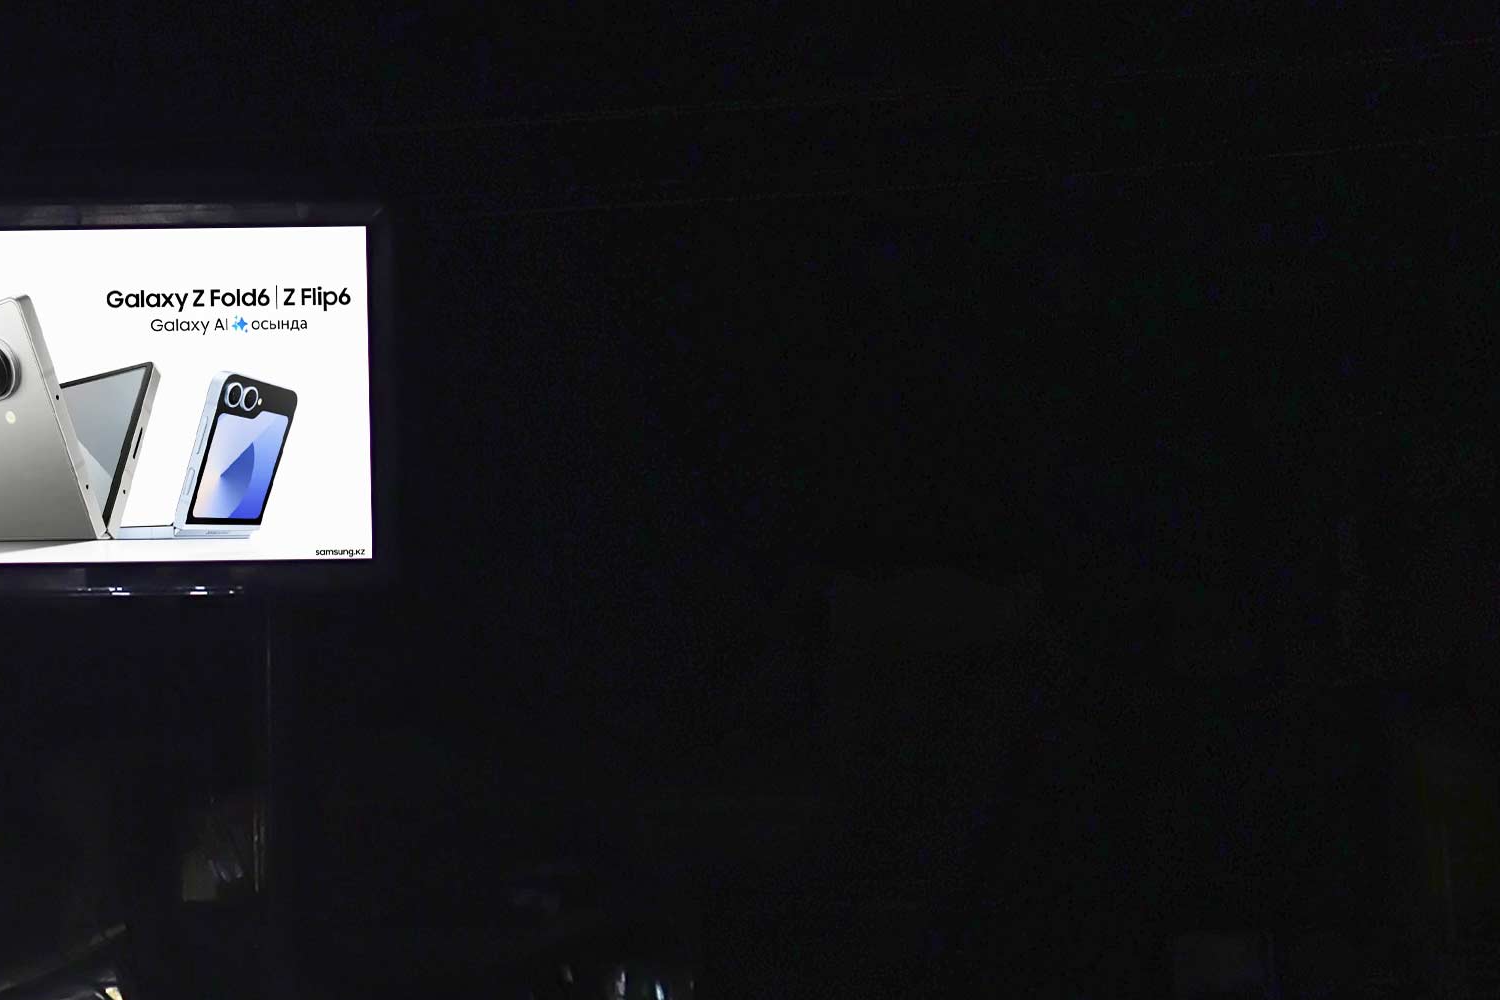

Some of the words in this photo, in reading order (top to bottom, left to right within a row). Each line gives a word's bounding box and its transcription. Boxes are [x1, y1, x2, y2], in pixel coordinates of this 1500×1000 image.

[106, 289, 189, 312] Galaxy
[192, 289, 205, 307] Z
[210, 288, 270, 307] Fold6
[283, 288, 296, 306] Z
[301, 286, 351, 311] Flip6
[150, 318, 210, 335] Galaxy
[214, 318, 228, 331] AI
[251, 319, 308, 332] осында
